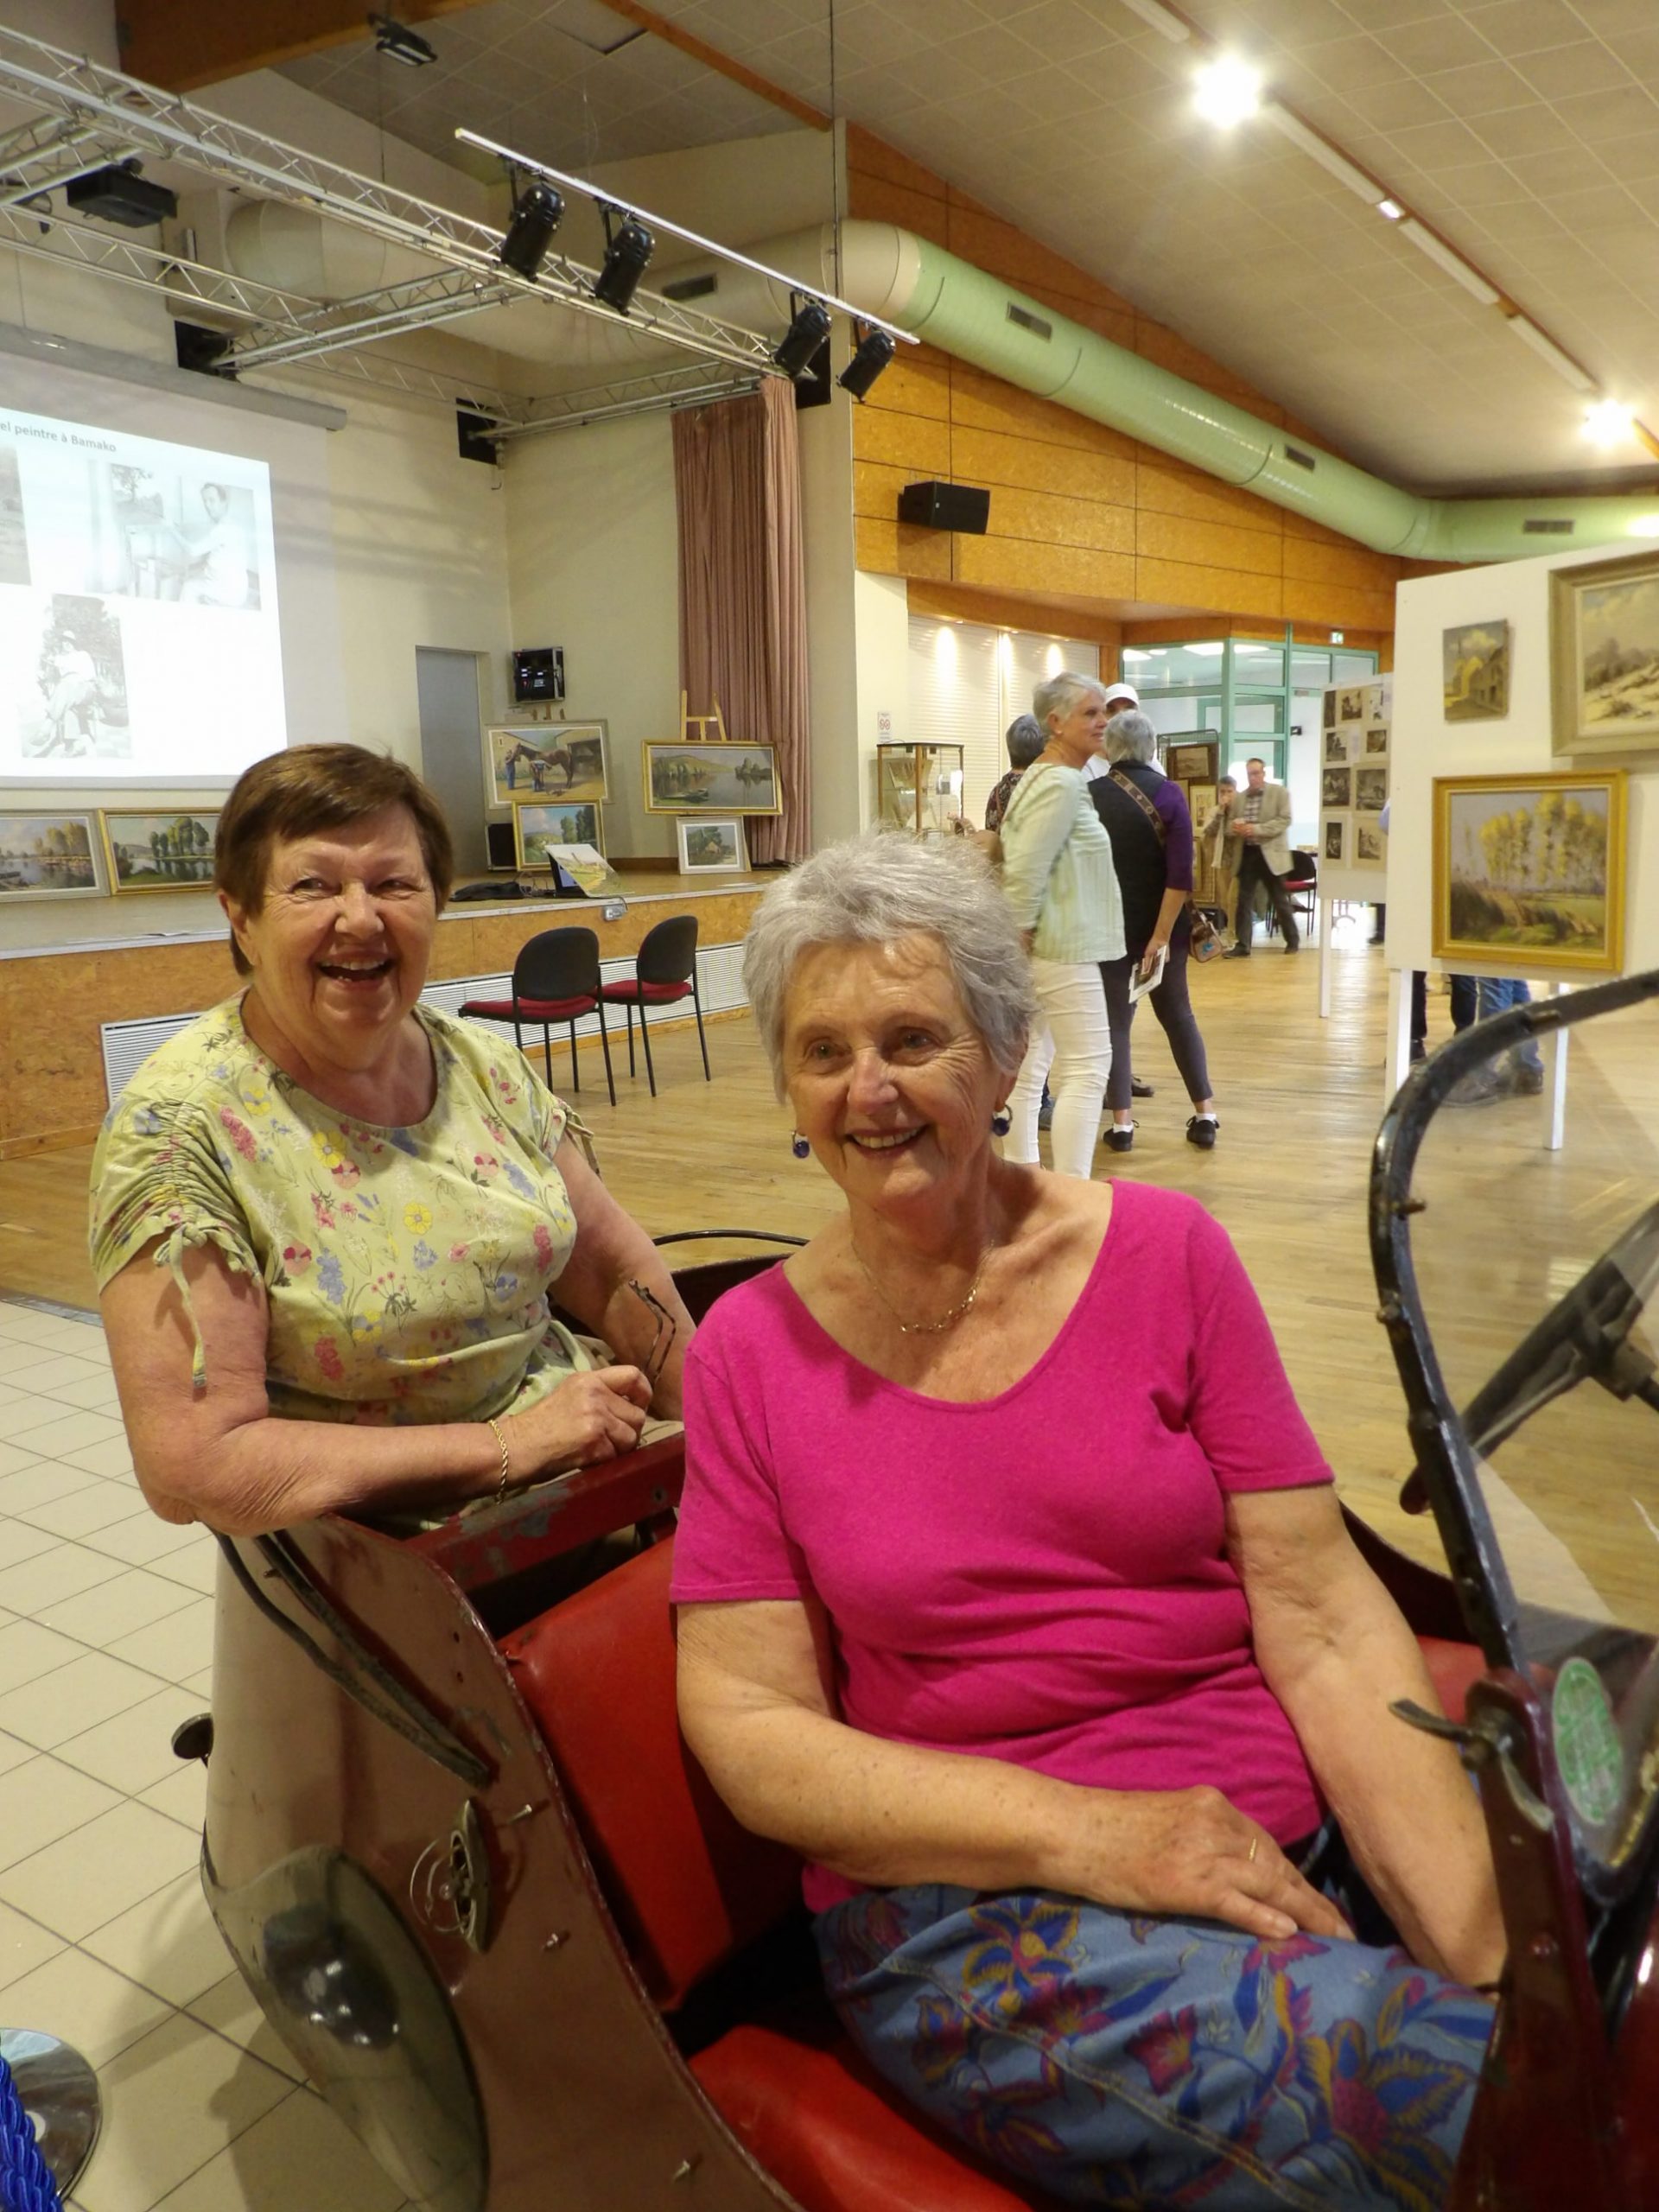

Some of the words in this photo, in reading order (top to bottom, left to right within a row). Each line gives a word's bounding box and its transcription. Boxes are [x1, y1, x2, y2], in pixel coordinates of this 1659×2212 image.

[0, 421, 11, 433] el
[15, 424, 58, 442] peintre
[60, 432, 68, 443] à
[71, 435, 117, 452] Bamako
